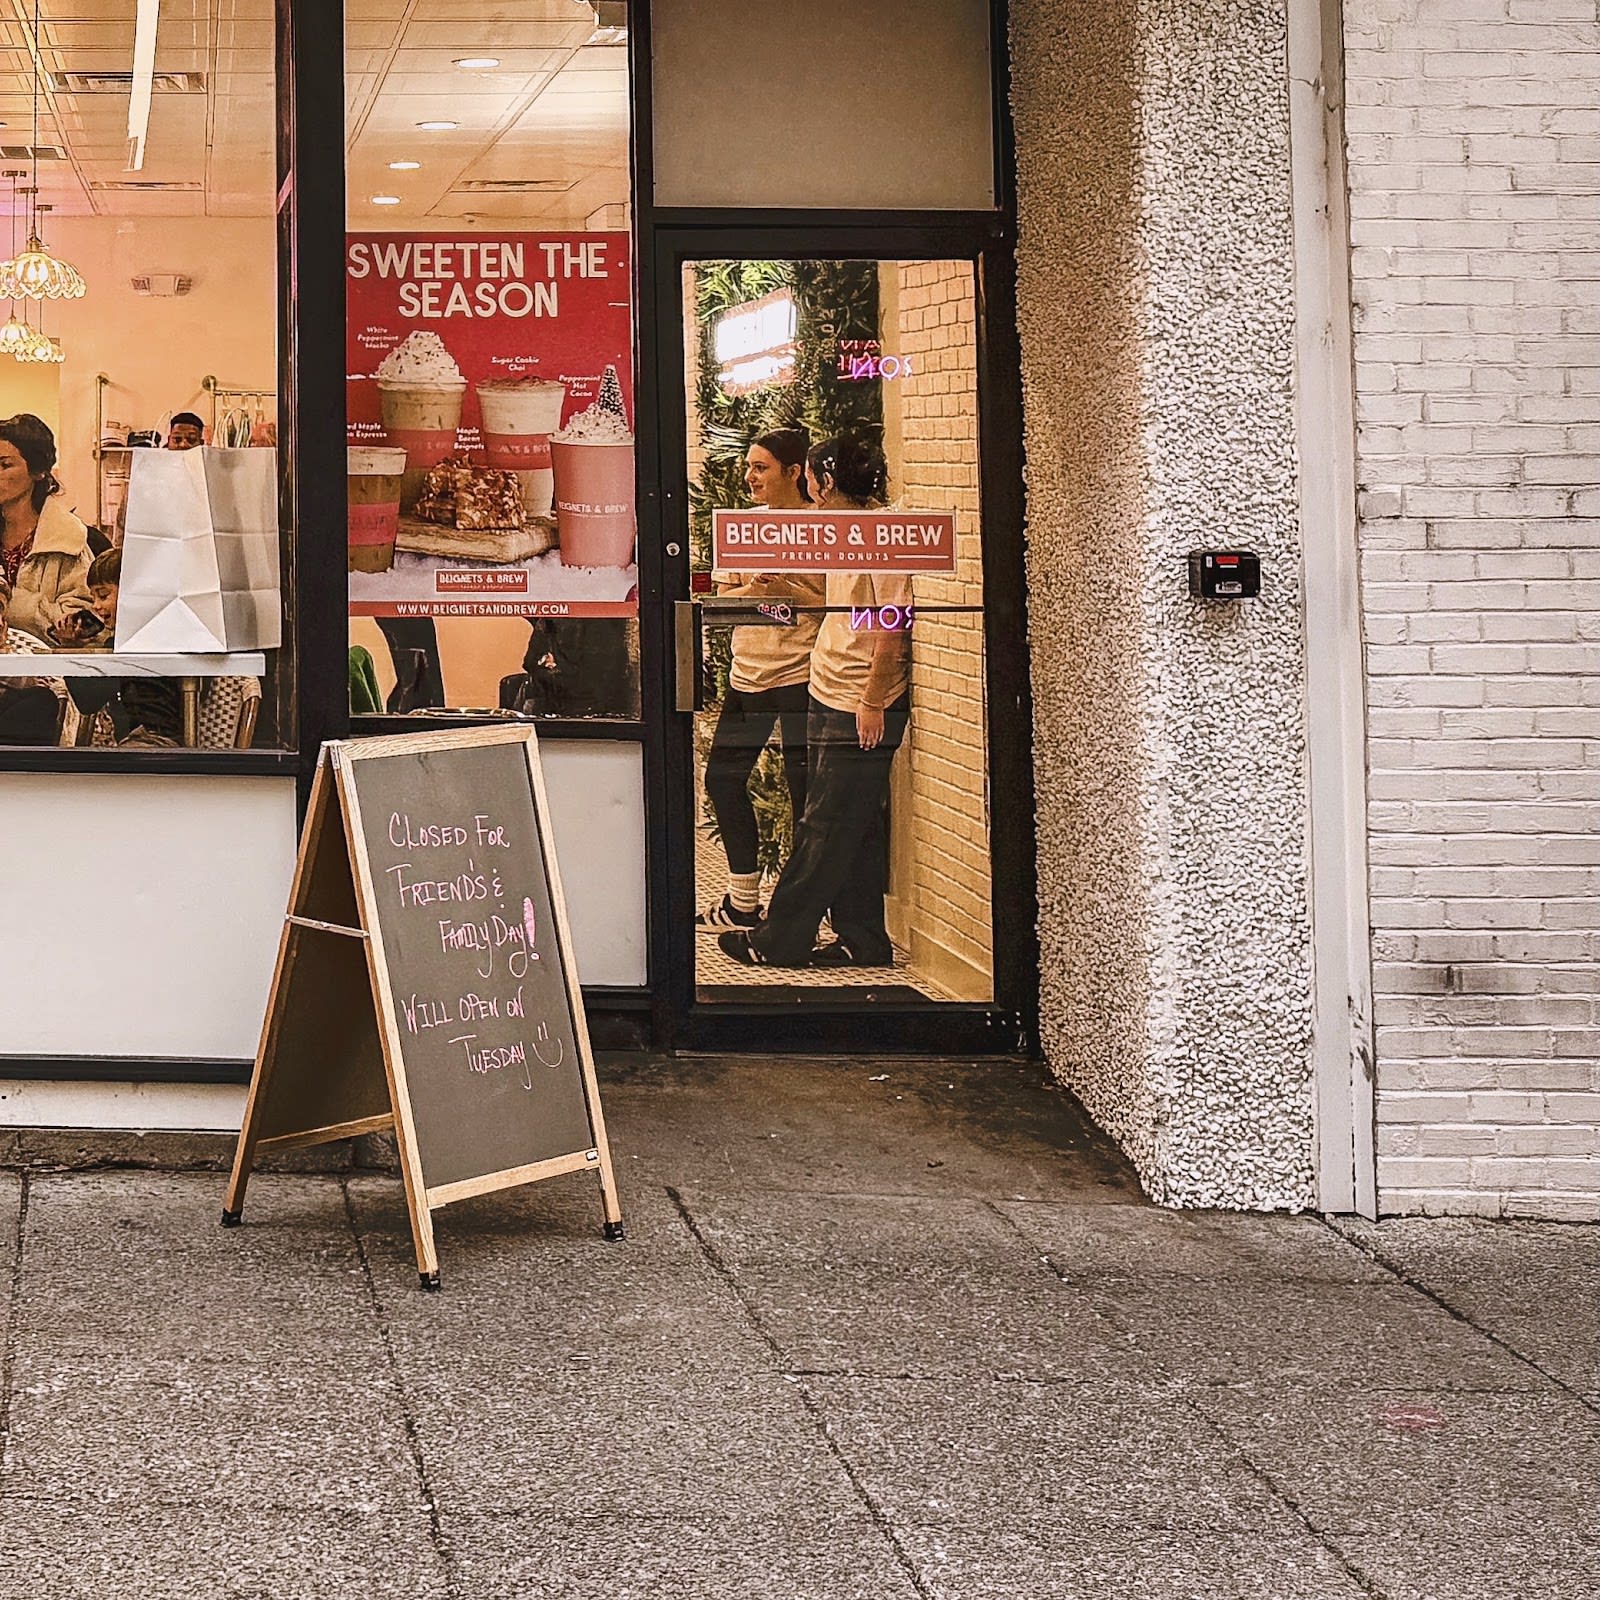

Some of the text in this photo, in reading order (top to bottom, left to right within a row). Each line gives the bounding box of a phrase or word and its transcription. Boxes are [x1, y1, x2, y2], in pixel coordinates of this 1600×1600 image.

[347, 241, 609, 279] SWEETEN THE
[398, 281, 559, 319] SEASON
[491, 355, 540, 365] Sugar Cookie
[508, 364, 526, 372] Chai
[558, 374, 602, 383] Peppermint
[569, 390, 593, 398] Cocoa
[455, 426, 480, 436] Maple
[457, 434, 481, 442] Bacon
[453, 442, 485, 452] Beignets
[725, 521, 943, 547] BEIGNETS & BREW
[781, 551, 889, 562] FRENCH DONUTS
[439, 573, 483, 584] BEIGNETS
[496, 574, 525, 584] BREW
